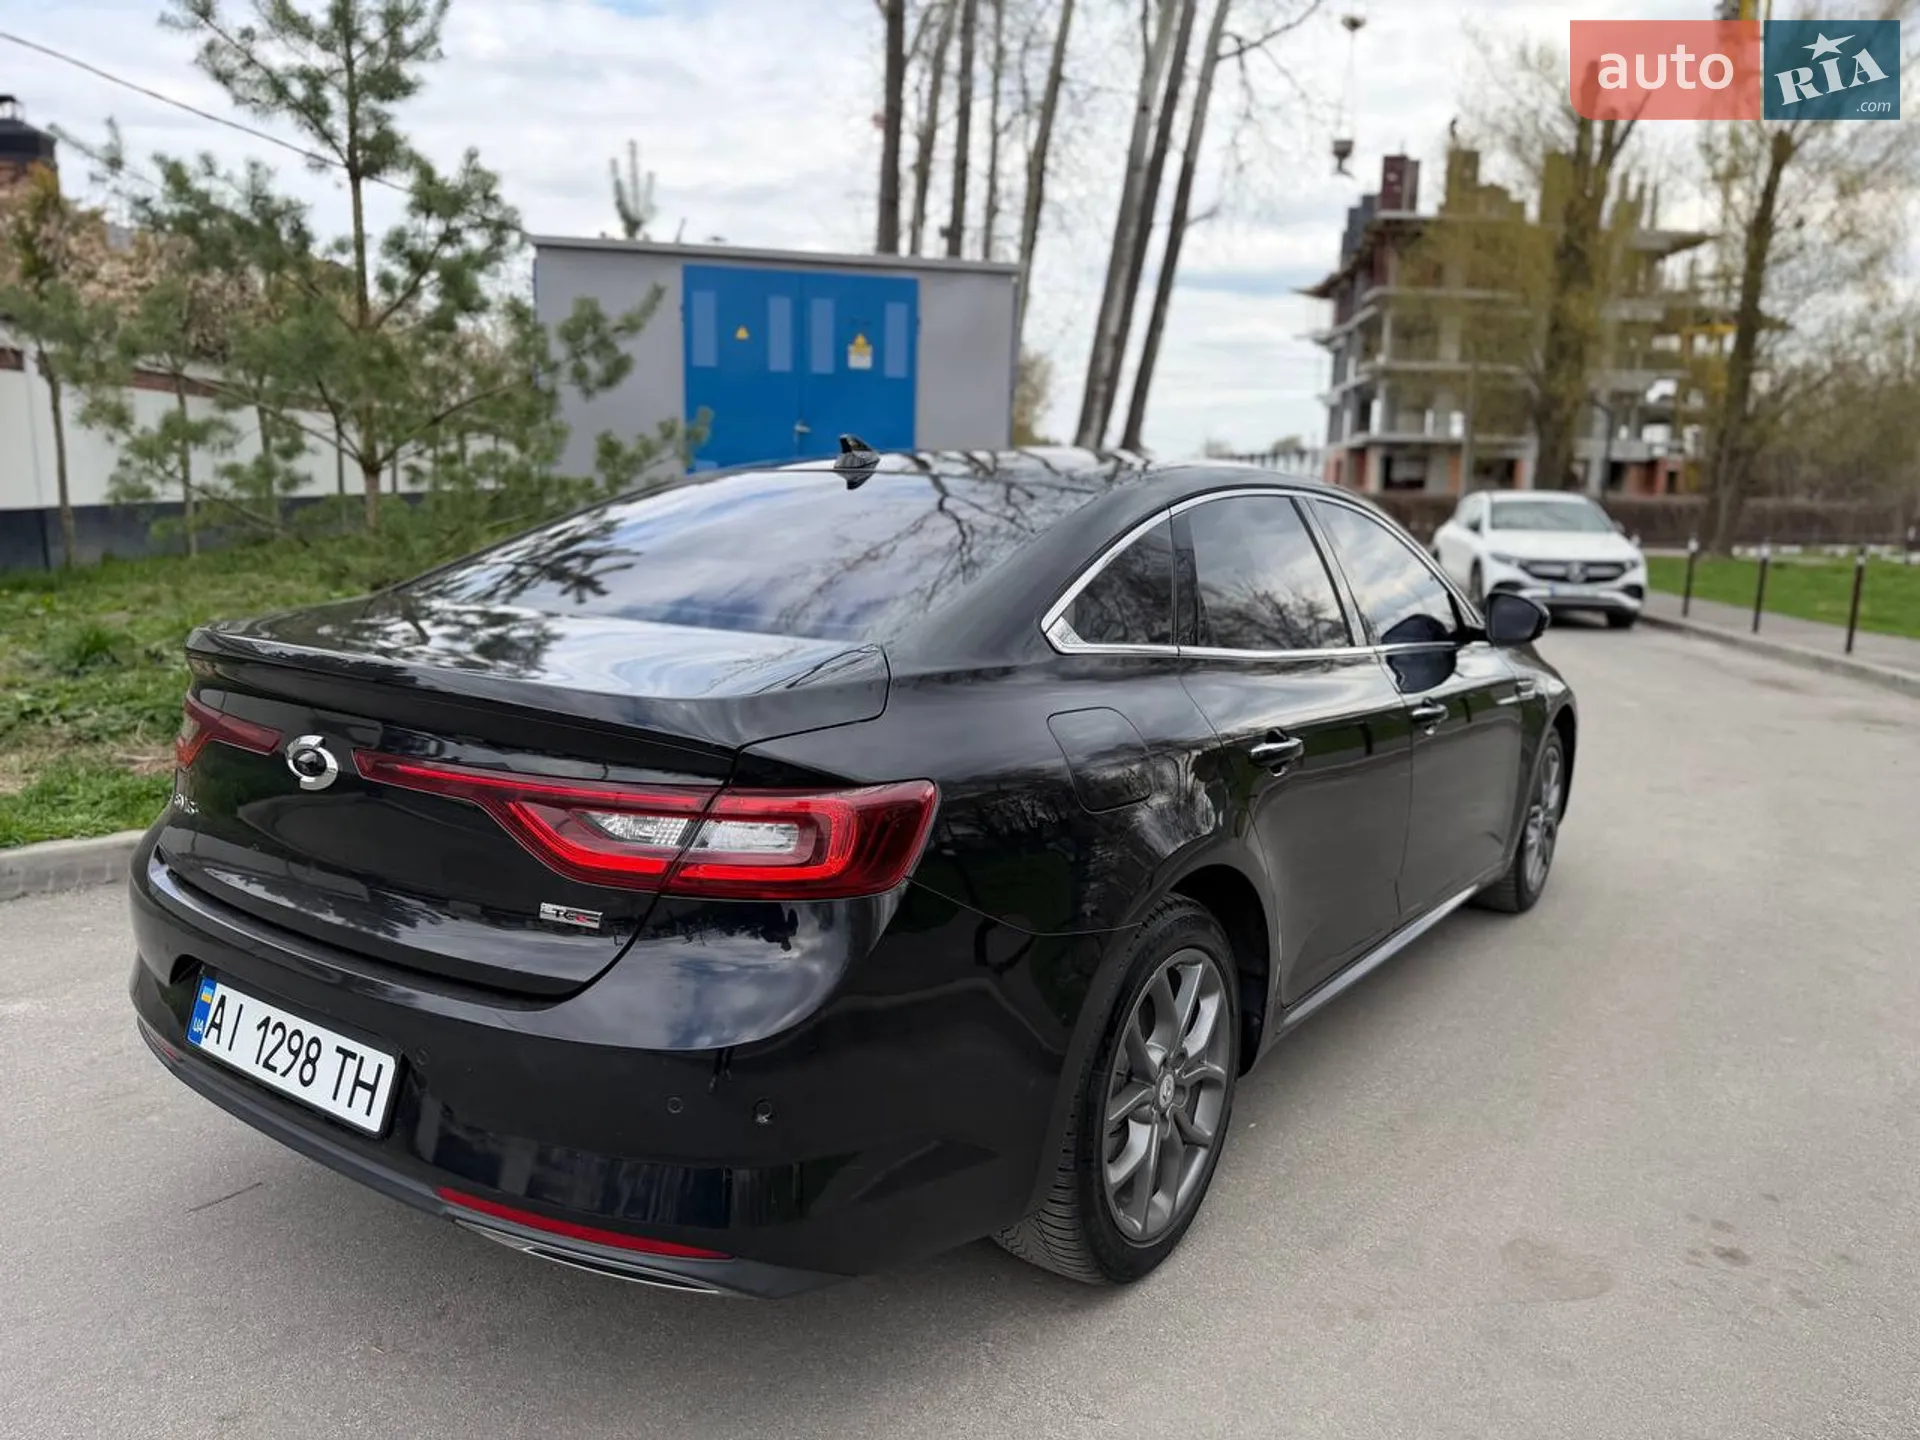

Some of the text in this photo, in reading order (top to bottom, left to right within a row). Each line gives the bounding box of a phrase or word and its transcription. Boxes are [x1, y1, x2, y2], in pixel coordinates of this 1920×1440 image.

[204, 994, 384, 1117] AI 1298 TH
